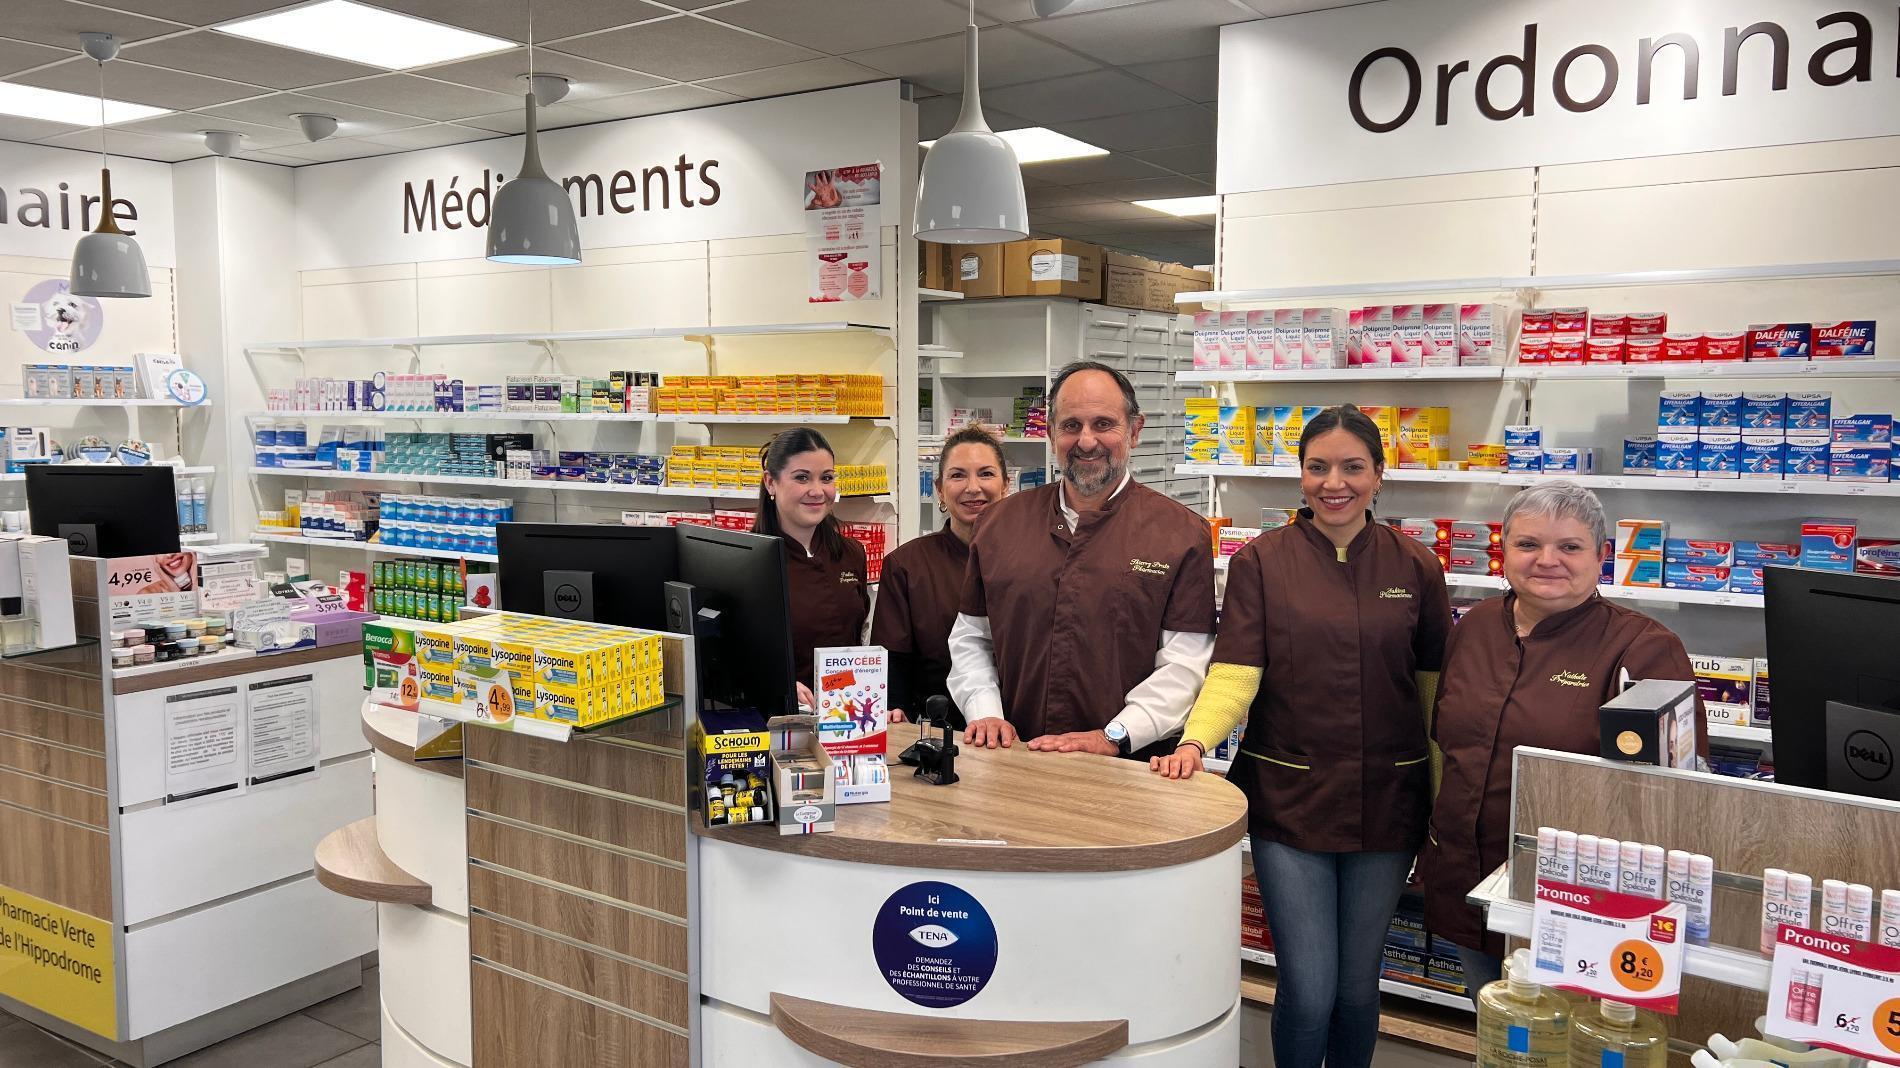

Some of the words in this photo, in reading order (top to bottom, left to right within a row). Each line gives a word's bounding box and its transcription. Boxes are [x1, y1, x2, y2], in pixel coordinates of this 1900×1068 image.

[1348, 10, 1900, 134] Ordonna
[0, 182, 138, 236] aire
[1755, 329, 1801, 340] DALFÉINE
[1819, 326, 1867, 338] DALFÉINE
[108, 571, 152, 588] 4,99€
[557, 594, 578, 602] DELL
[315, 602, 346, 613] 3,99€
[366, 633, 393, 644] Berocca
[415, 636, 450, 649] Lysopaine
[454, 640, 488, 655] Lysopaine
[492, 648, 532, 662] Lysopaine
[534, 653, 574, 668] Lysopaine
[826, 656, 882, 667] ERGYCÉBÉ
[420, 670, 450, 682] ysopaine
[536, 689, 575, 706] Lysopaine
[714, 736, 760, 749] SCHOUM
[1850, 746, 1887, 765] DELL
[1538, 856, 1569, 872] Offre
[1579, 864, 1611, 879] Offre
[1622, 870, 1656, 886] Offre
[1536, 884, 1590, 905] Promos
[1670, 880, 1704, 896] Offre
[928, 895, 940, 904] Ici
[900, 906, 924, 917] Point
[927, 908, 939, 918] de
[941, 910, 968, 919] vente
[1766, 902, 1802, 918] Offre
[0, 896, 58, 934] harmacie
[60, 918, 95, 948] Verte
[1826, 915, 1863, 932] Offre
[918, 931, 948, 941] TENA
[1784, 928, 1850, 954] Promos
[14, 932, 102, 984] l'Hippodrome
[916, 957, 952, 965] DEMANDEZ
[1428, 958, 1455, 971] Asthé
[902, 971, 951, 981] ÉCHANTILLONS
[920, 965, 952, 973] CONSEILS
[892, 978, 944, 989] PROFESSIONNEL
[956, 982, 976, 991] SANTÉ
